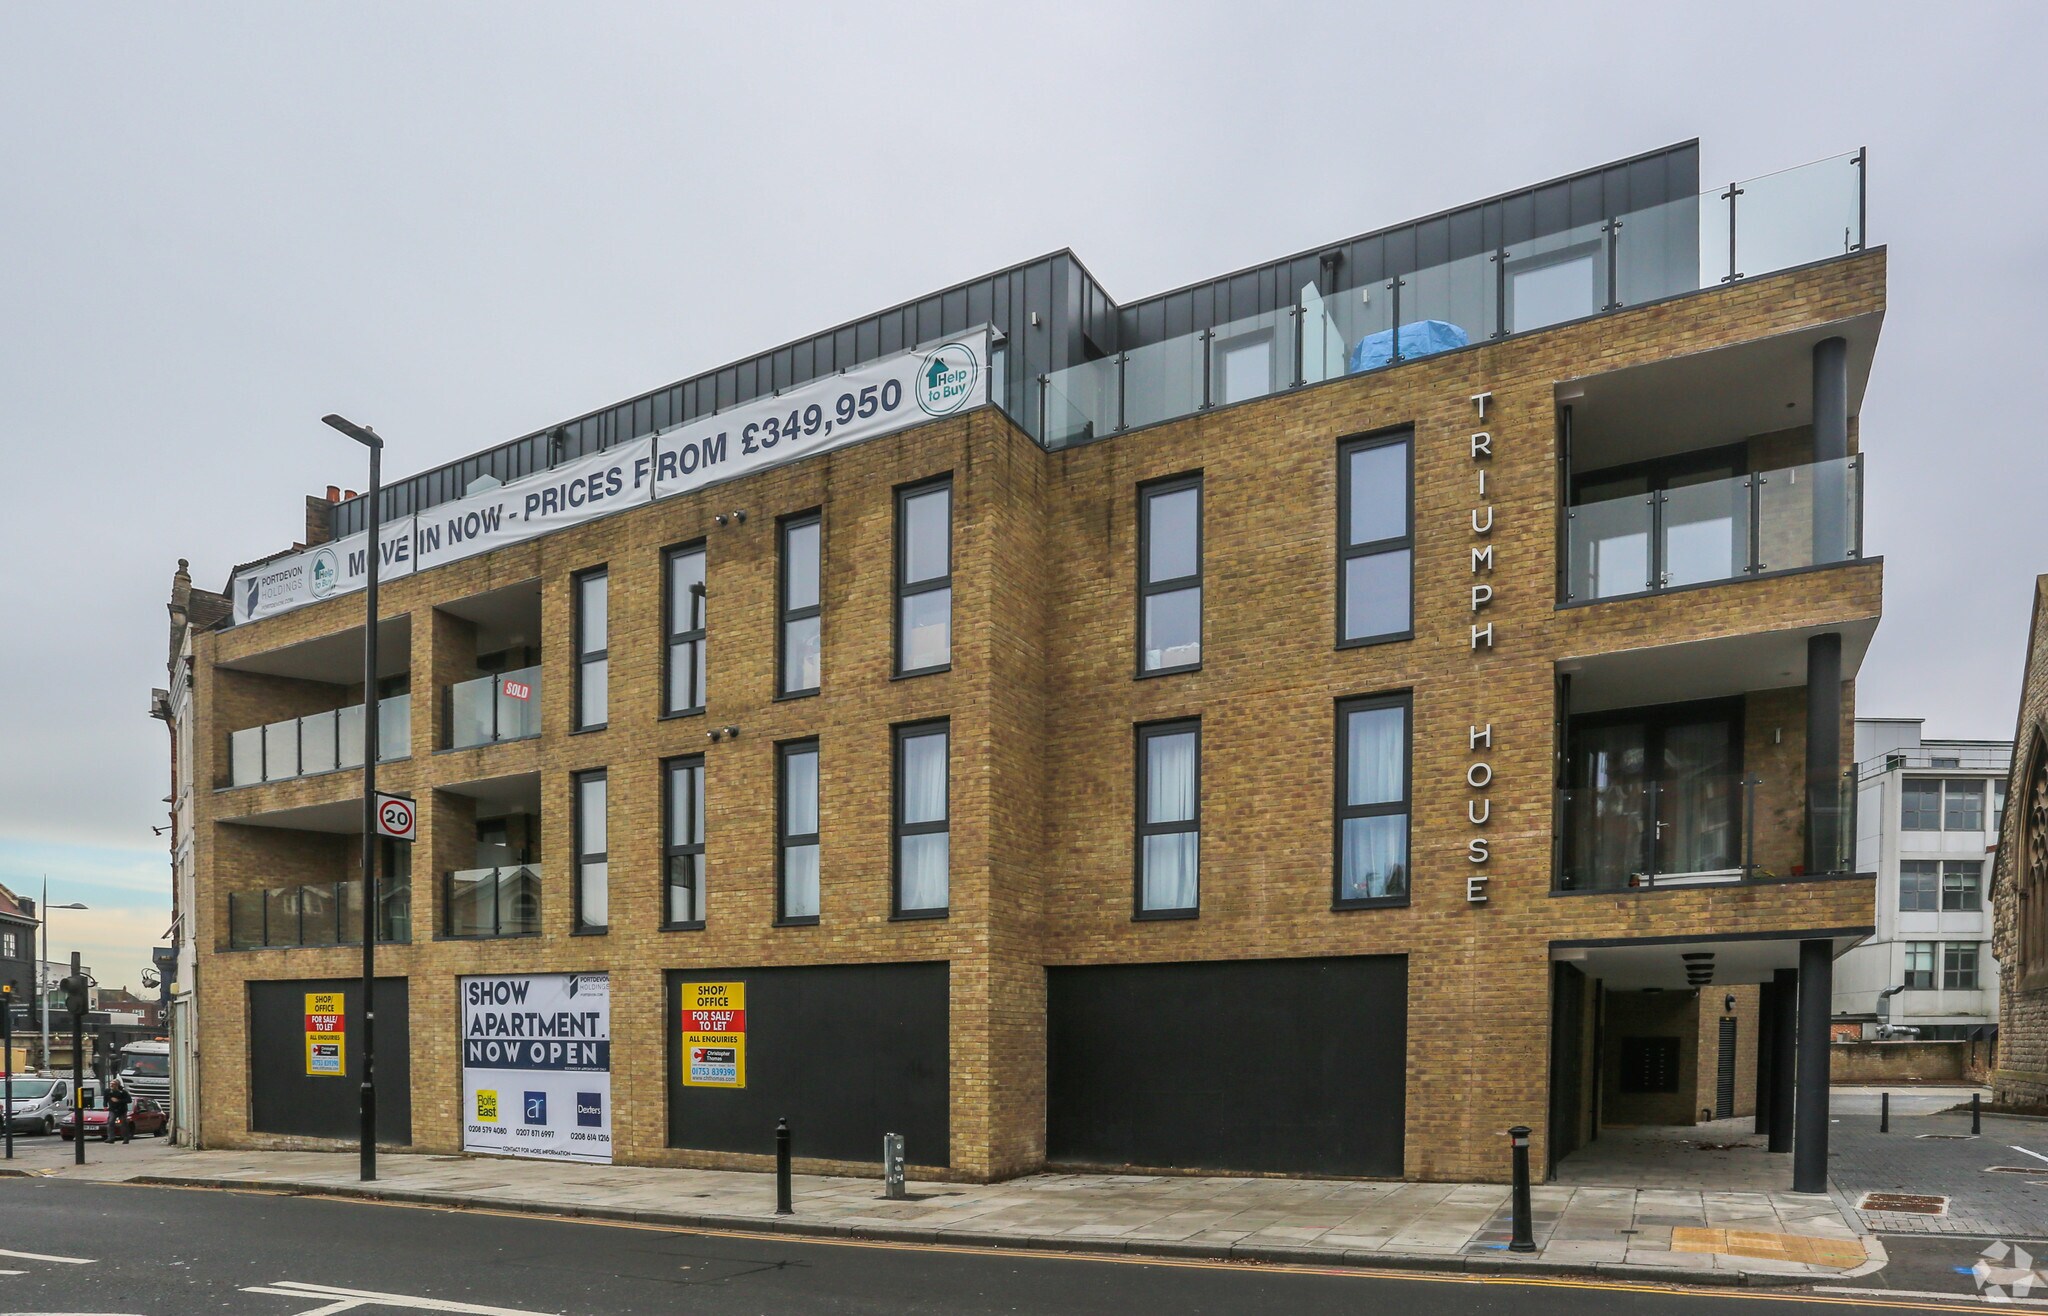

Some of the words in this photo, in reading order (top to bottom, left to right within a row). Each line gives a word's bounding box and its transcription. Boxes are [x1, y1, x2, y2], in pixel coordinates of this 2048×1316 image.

[938, 369, 967, 387] Help
[928, 390, 940, 402] to
[943, 383, 966, 399] Buy
[349, 534, 409, 577] MVE
[419, 524, 440, 554] IN
[448, 504, 503, 545] NOW
[524, 466, 622, 521] PRICES
[634, 432, 727, 489] FROM
[741, 378, 902, 455] £349,950
[1471, 391, 1493, 649] TRIUMPH
[262, 565, 303, 587] PORTDEVON
[320, 568, 334, 579] Help
[262, 579, 303, 600] HOLDINGS
[506, 682, 529, 699] SOLD
[385, 809, 408, 826] 20
[1467, 723, 1492, 902] HOUSE
[468, 981, 530, 1006] SHOW
[698, 985, 727, 995] SHOP/
[315, 995, 333, 1003] SHOP/
[697, 997, 729, 1007] OFFICE
[314, 1004, 335, 1012] OFFICE
[311, 1015, 322, 1023] FOR
[323, 1015, 338, 1024] SALE/
[692, 1011, 709, 1021] FOR
[710, 1011, 734, 1022] SALE/
[316, 1023, 324, 1031] TO
[324, 1023, 333, 1031] LET
[470, 1012, 605, 1037] APARTMENT.
[699, 1021, 711, 1031] TO
[713, 1021, 727, 1031] LET
[469, 1041, 521, 1063] NOW
[530, 1042, 597, 1065] OPEN
[692, 1067, 710, 1075] 01753
[478, 1094, 496, 1106] Rolfe
[478, 1105, 497, 1117] East
[577, 1104, 601, 1114] Dexters
[468, 1125, 481, 1133] 0208
[516, 1128, 529, 1136] 0207
[531, 1129, 540, 1137] 871
[541, 1130, 555, 1138] 6997
[571, 1132, 585, 1140] 0208
[587, 1133, 596, 1141] 614
[598, 1134, 609, 1142] 1216
